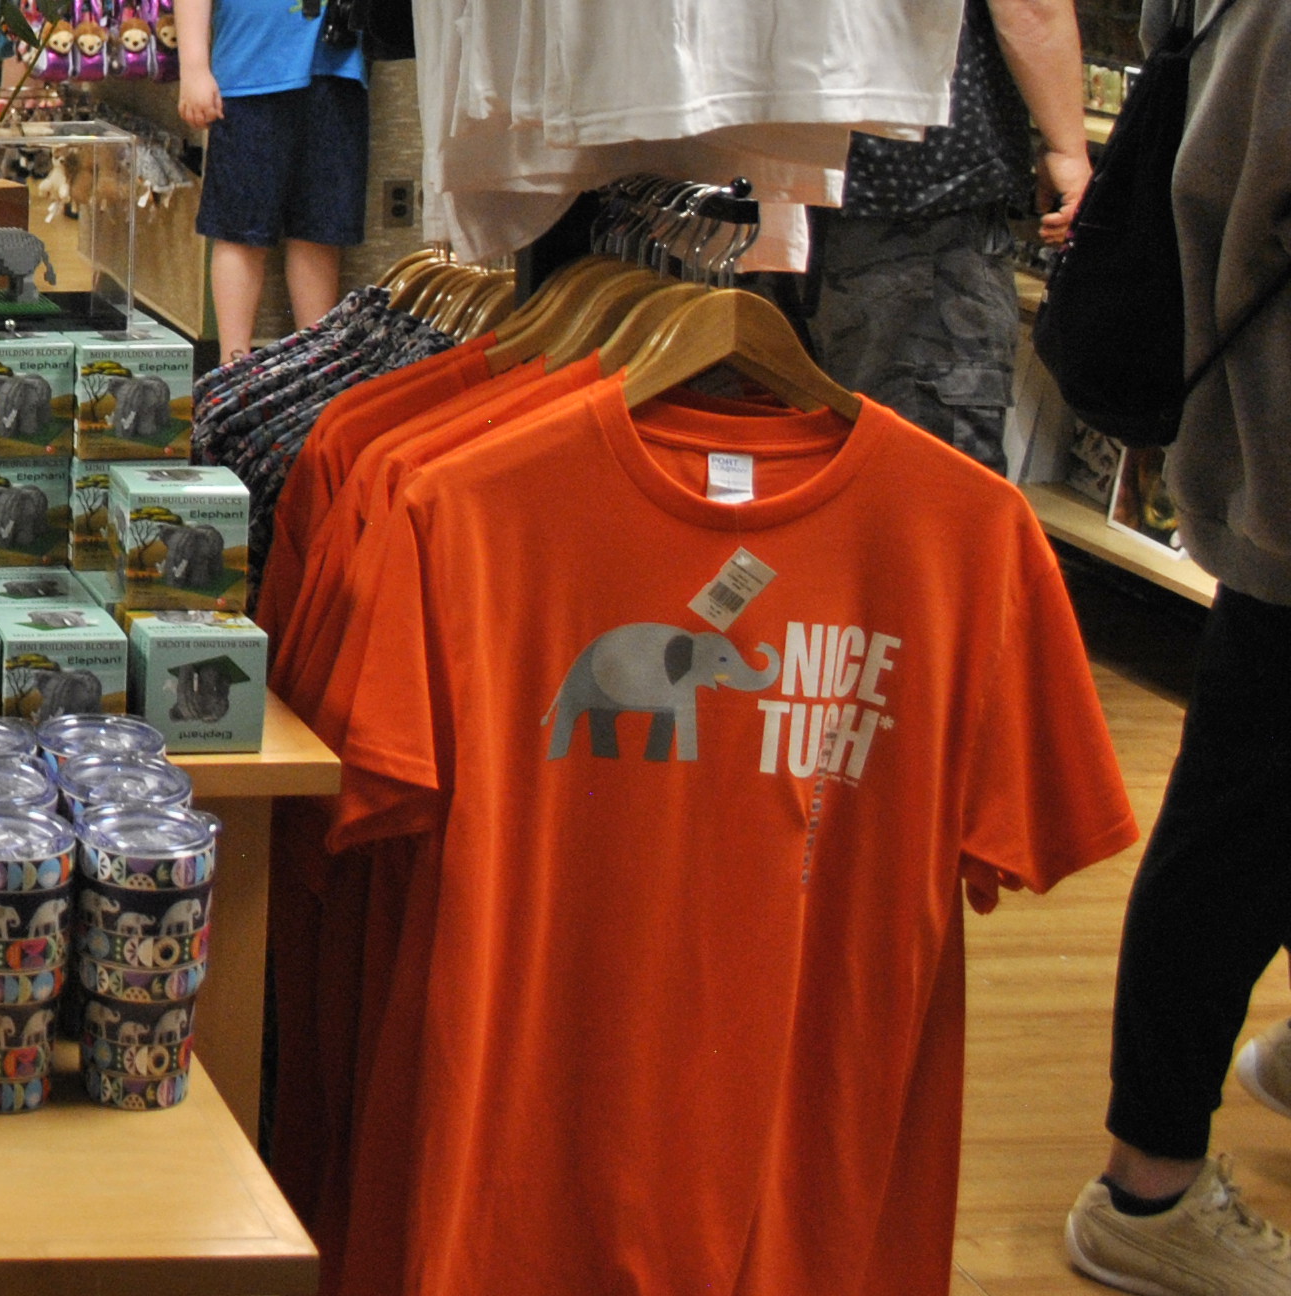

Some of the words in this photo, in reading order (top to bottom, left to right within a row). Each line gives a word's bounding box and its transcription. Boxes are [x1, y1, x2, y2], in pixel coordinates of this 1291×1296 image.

[36, 347, 68, 357] BLOCKS
[90, 350, 110, 359] MINI
[113, 350, 152, 359] BUILDING
[155, 350, 188, 359] BLOCKS
[19, 360, 70, 372] Elephant
[138, 361, 190, 373] Elephant
[189, 508, 244, 520] Elephant
[15, 643, 37, 652] MINI
[40, 642, 82, 652] BUILDING
[85, 642, 120, 651] BLOCKS
[67, 654, 122, 667] Elephant
[781, 621, 901, 706] NICE
[178, 730, 233, 741] Elephant
